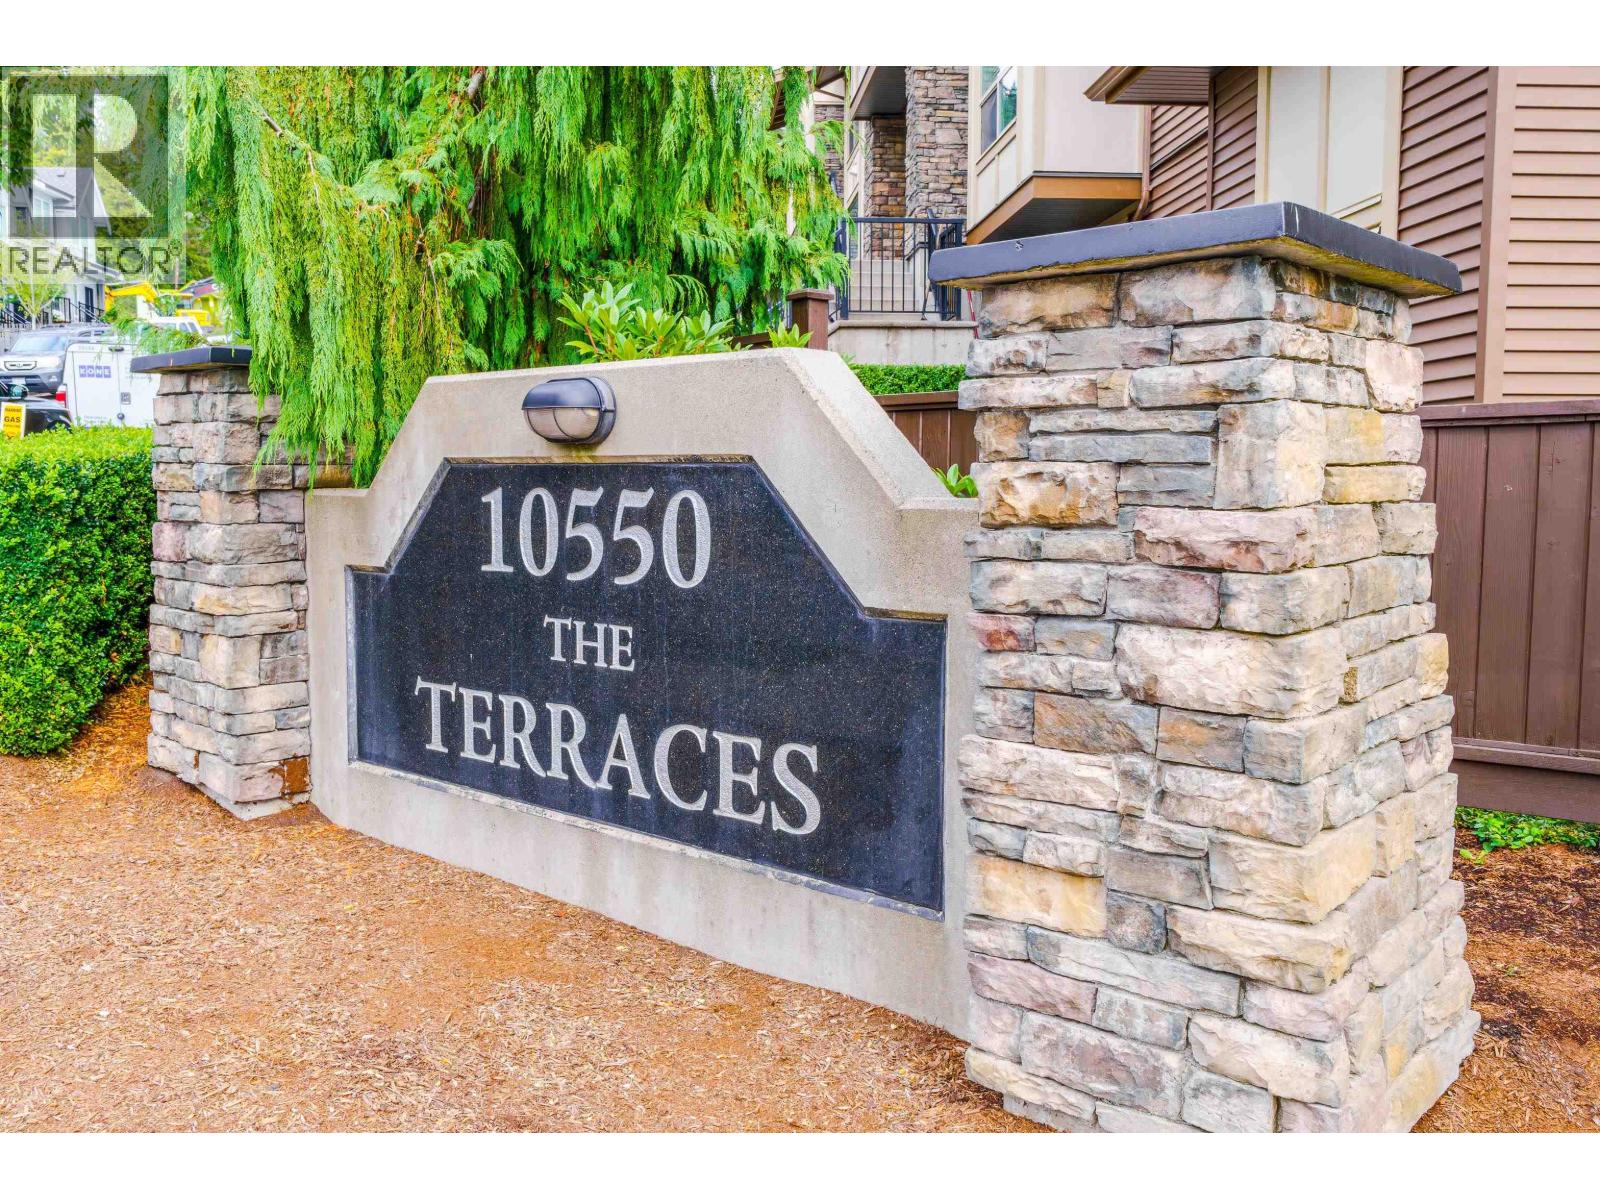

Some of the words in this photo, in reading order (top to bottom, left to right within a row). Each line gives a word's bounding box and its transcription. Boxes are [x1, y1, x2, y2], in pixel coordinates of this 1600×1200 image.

[79, 366, 111, 377] KONE
[480, 487, 712, 590] 10550
[543, 615, 636, 672] THE
[414, 675, 822, 836] TERRACES
